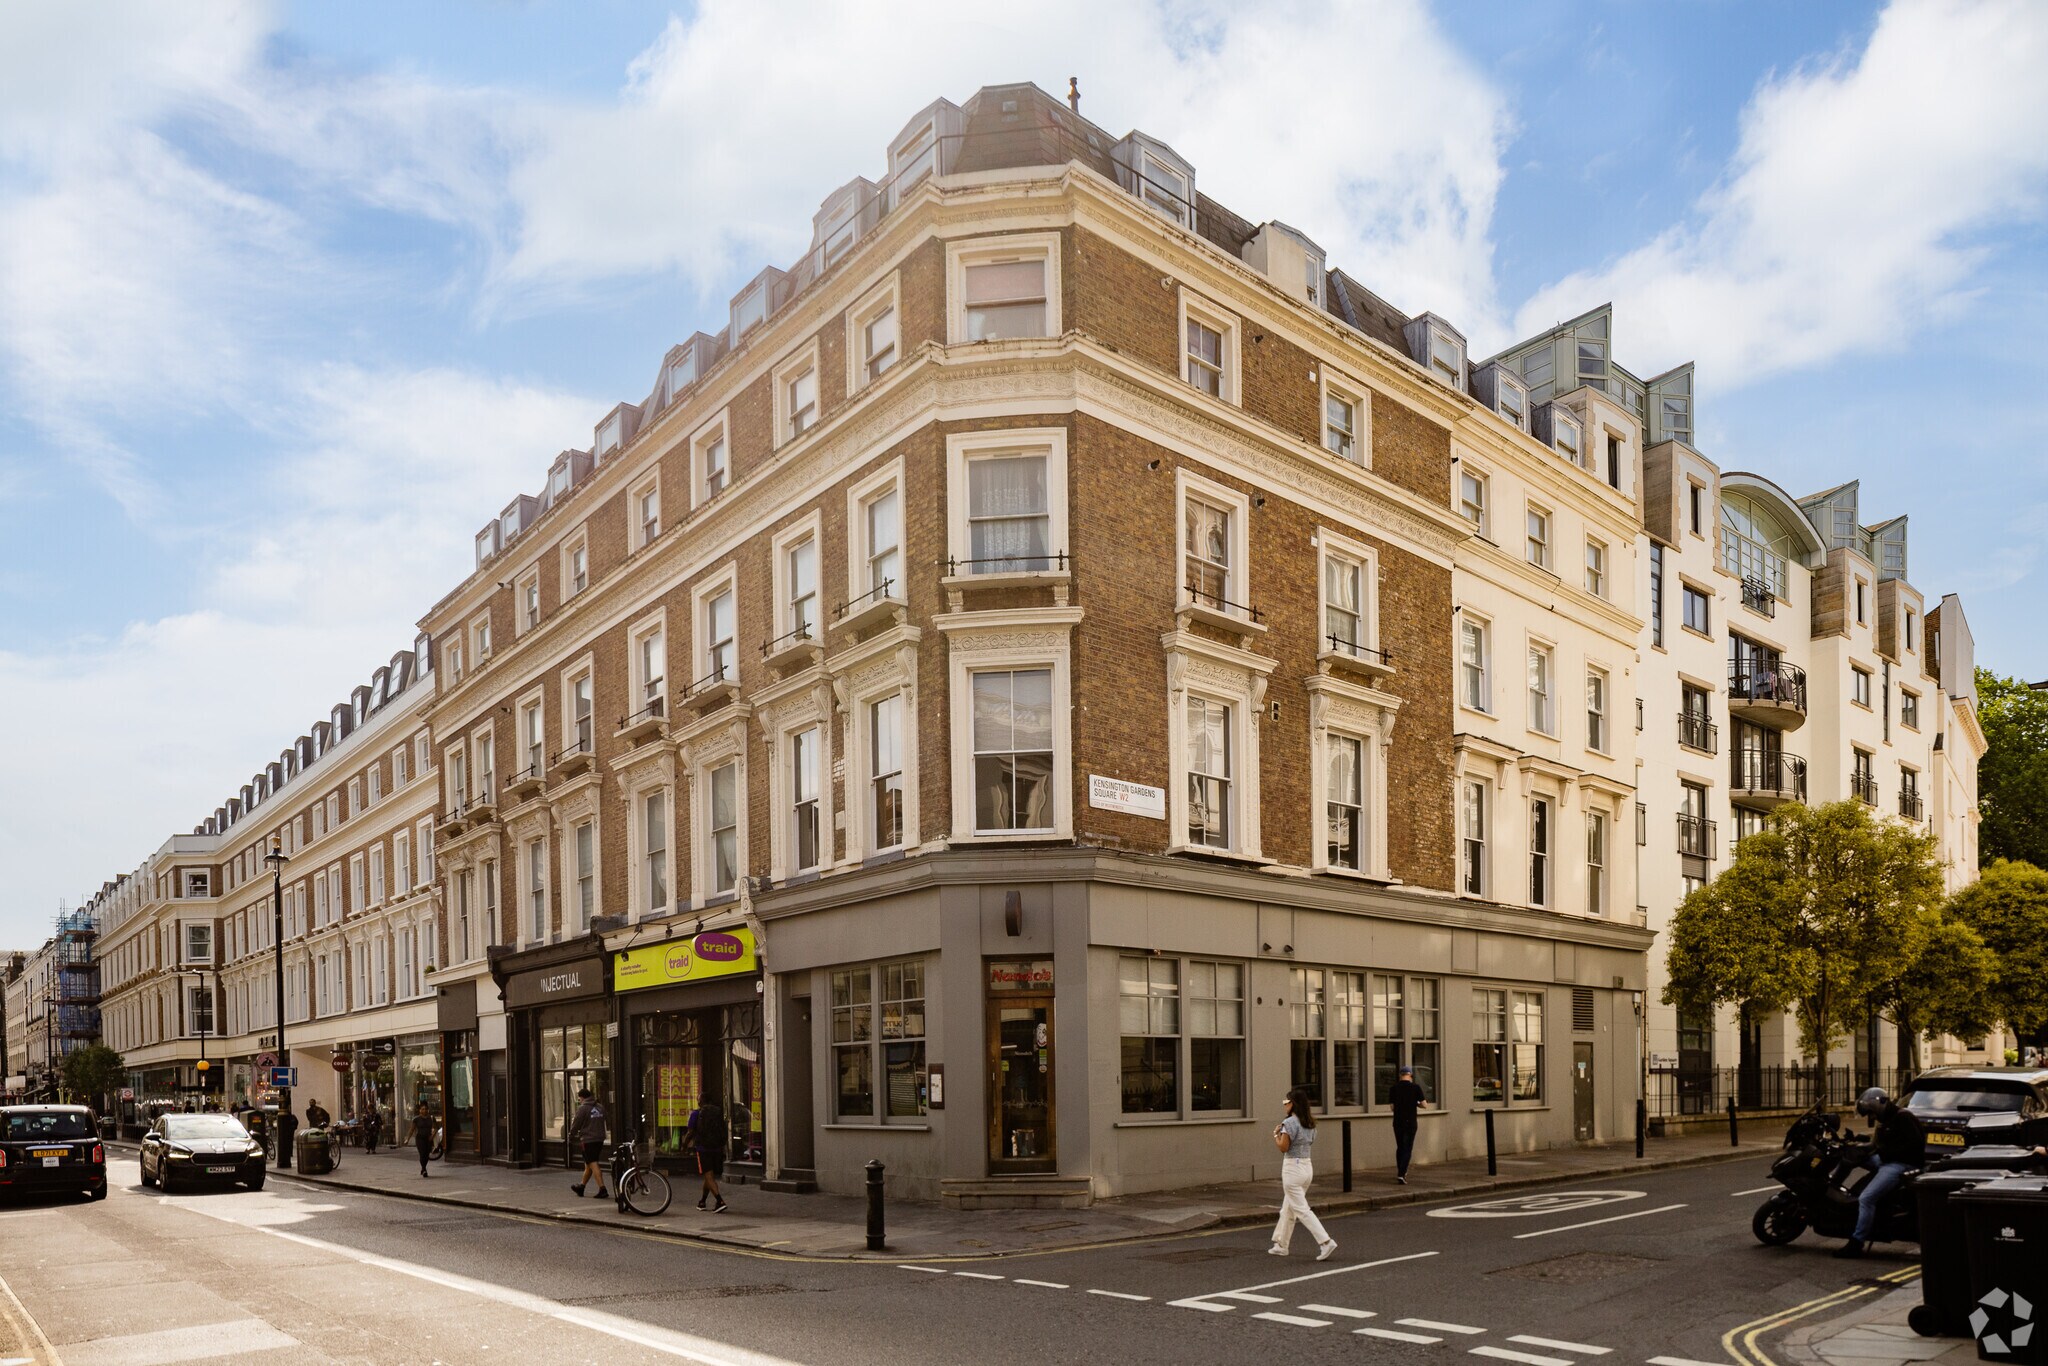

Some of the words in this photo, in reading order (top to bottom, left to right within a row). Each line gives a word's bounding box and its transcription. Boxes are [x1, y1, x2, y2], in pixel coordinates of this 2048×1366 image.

[1093, 778, 1130, 793] KENSINGTON
[1130, 785, 1156, 799] GARDENS
[1094, 788, 1117, 800] SQUARE
[1119, 793, 1129, 802] W2
[702, 941, 737, 954] traid
[669, 955, 689, 970] traid
[541, 971, 581, 993] INJECTUAL
[660, 1067, 699, 1077] SALE
[660, 1077, 699, 1087] SALE
[660, 1086, 699, 1097] SALE
[1933, 1134, 1955, 1143] LV21
